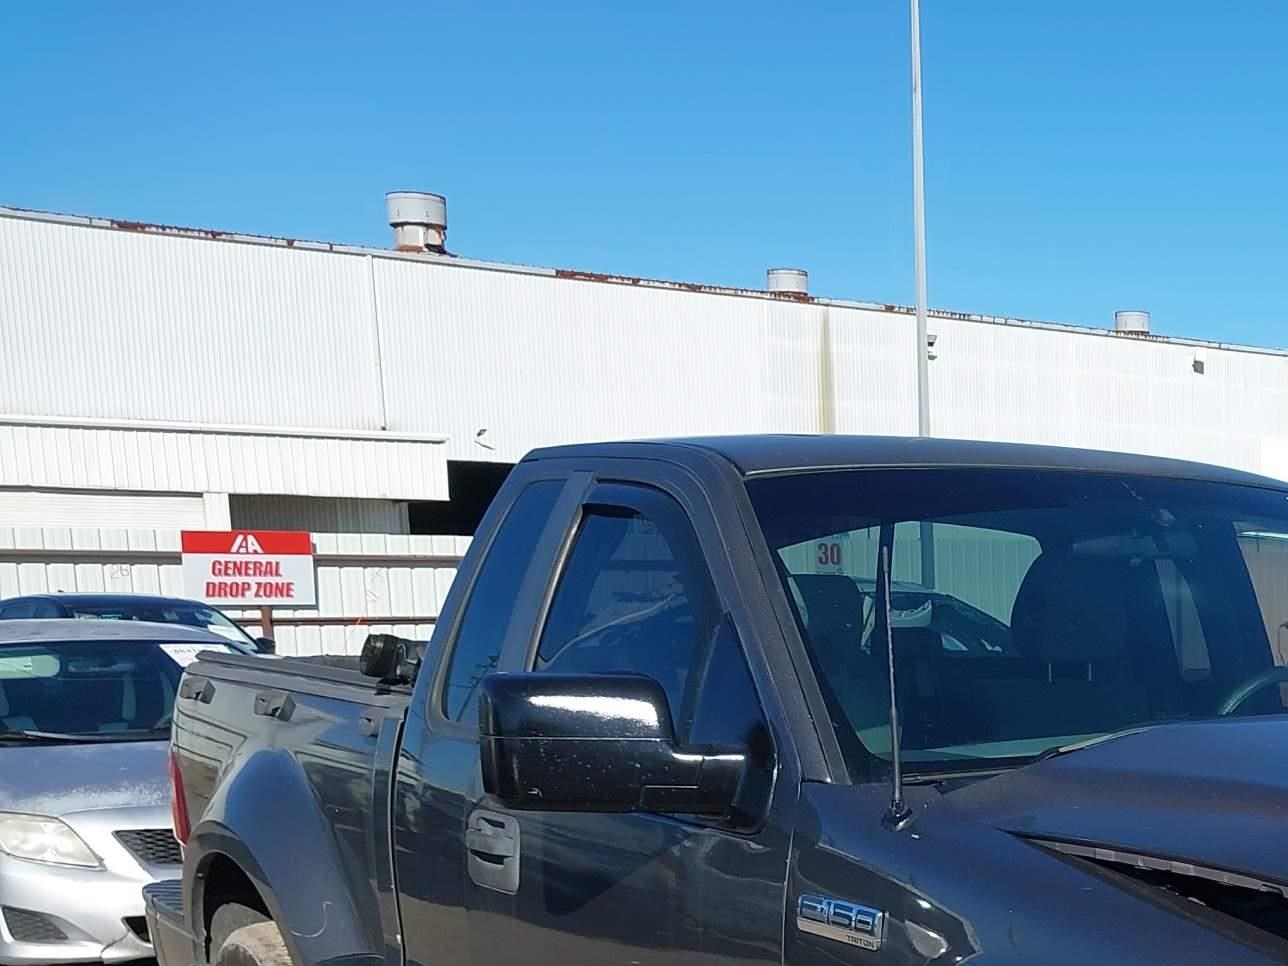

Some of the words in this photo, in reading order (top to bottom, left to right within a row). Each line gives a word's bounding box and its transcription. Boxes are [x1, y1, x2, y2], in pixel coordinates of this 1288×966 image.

[818, 543, 841, 565] 30
[211, 560, 282, 577] GENERAL
[206, 582, 251, 598] DROP
[254, 582, 295, 598] ZONE
[846, 934, 875, 948] TRITON
